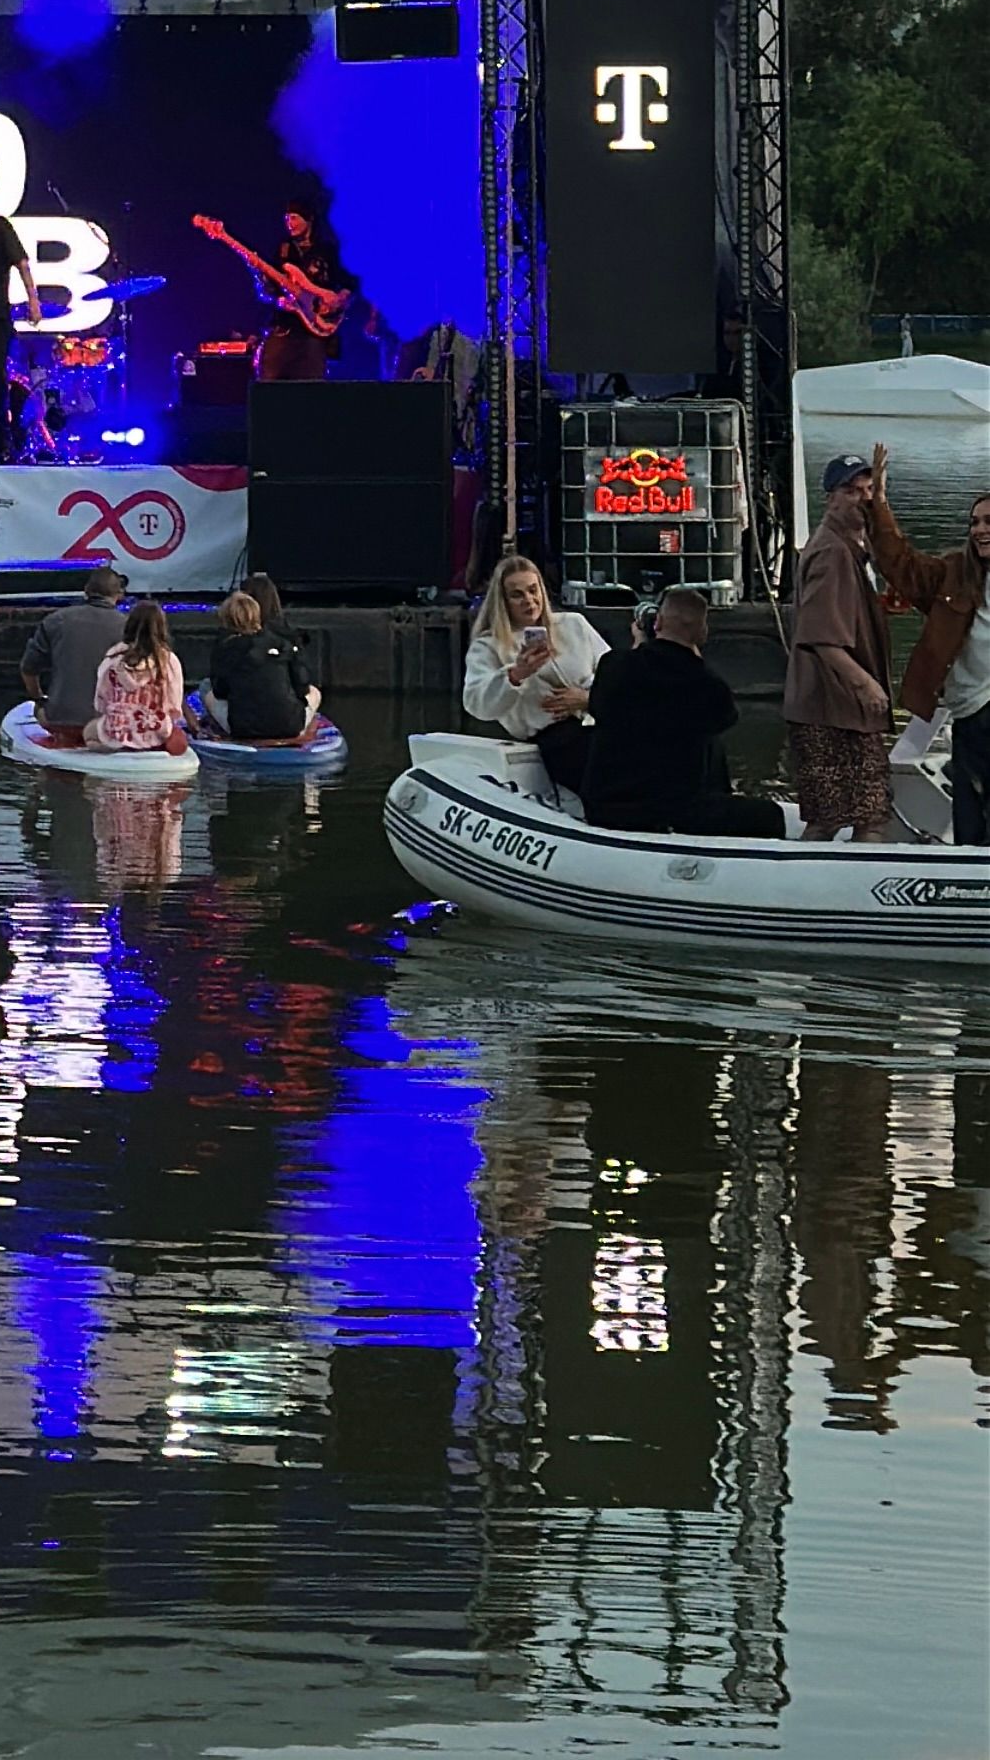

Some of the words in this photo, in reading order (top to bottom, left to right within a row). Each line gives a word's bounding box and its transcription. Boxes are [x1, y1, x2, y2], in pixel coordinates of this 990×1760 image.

[596, 66, 668, 149] T
[8, 216, 113, 332] B
[138, 513, 159, 536] T
[594, 486, 645, 513] Red
[648, 485, 695, 513] Bull
